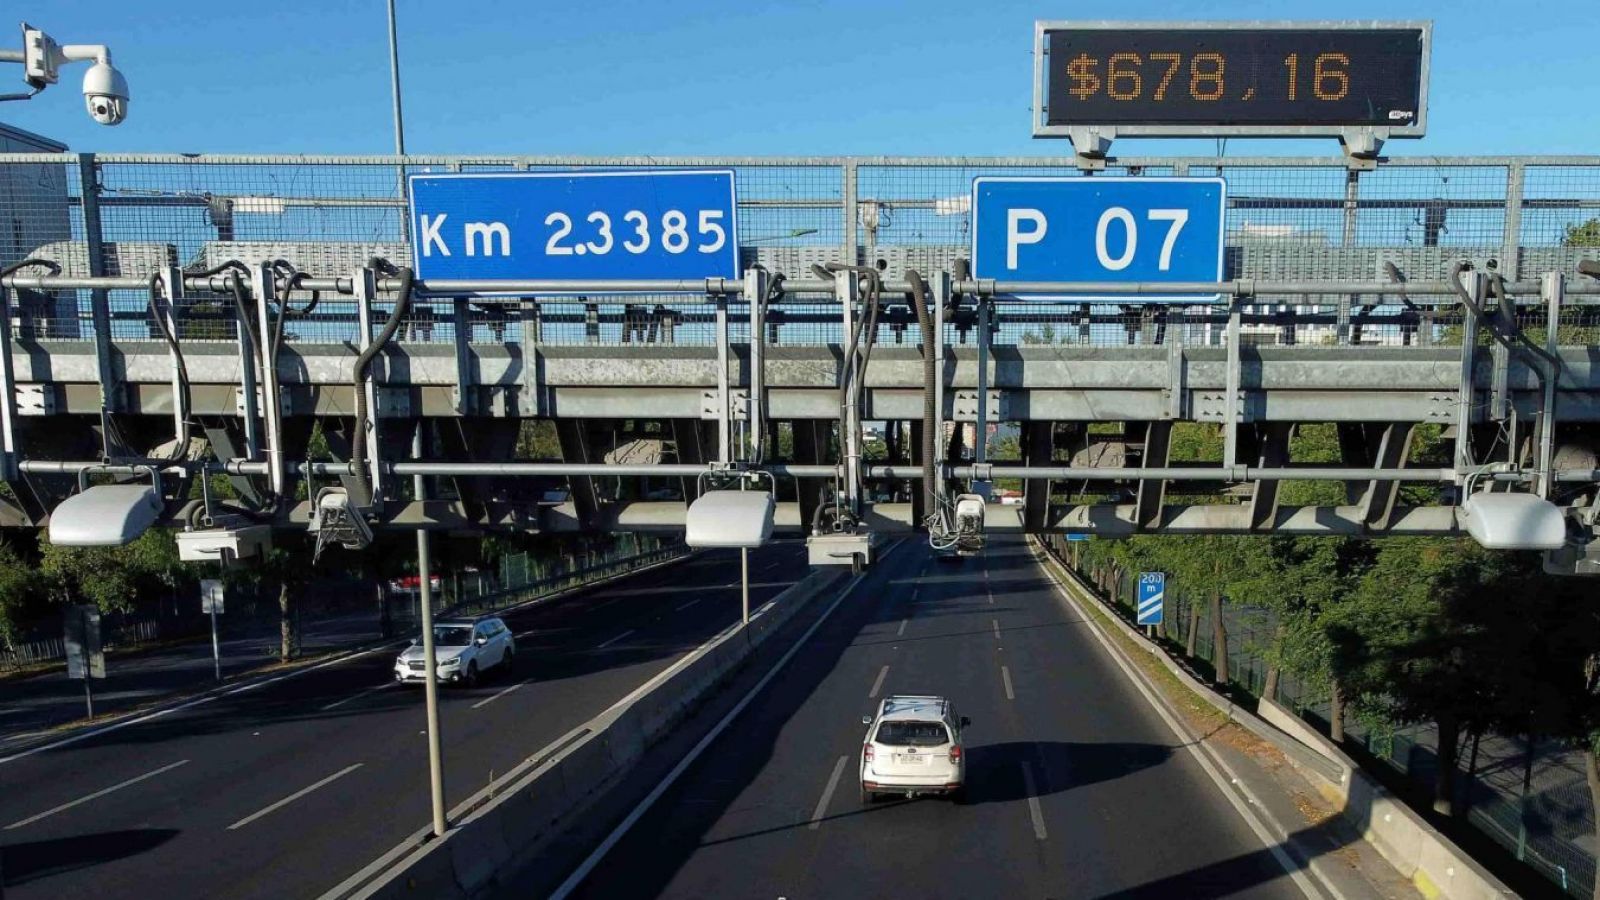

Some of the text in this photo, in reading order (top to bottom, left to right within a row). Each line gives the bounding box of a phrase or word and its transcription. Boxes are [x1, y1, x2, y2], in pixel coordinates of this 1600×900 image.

[420, 209, 726, 257] Km 2.3385
[1006, 206, 1189, 271] P 07
[1141, 574, 1162, 585] 200
